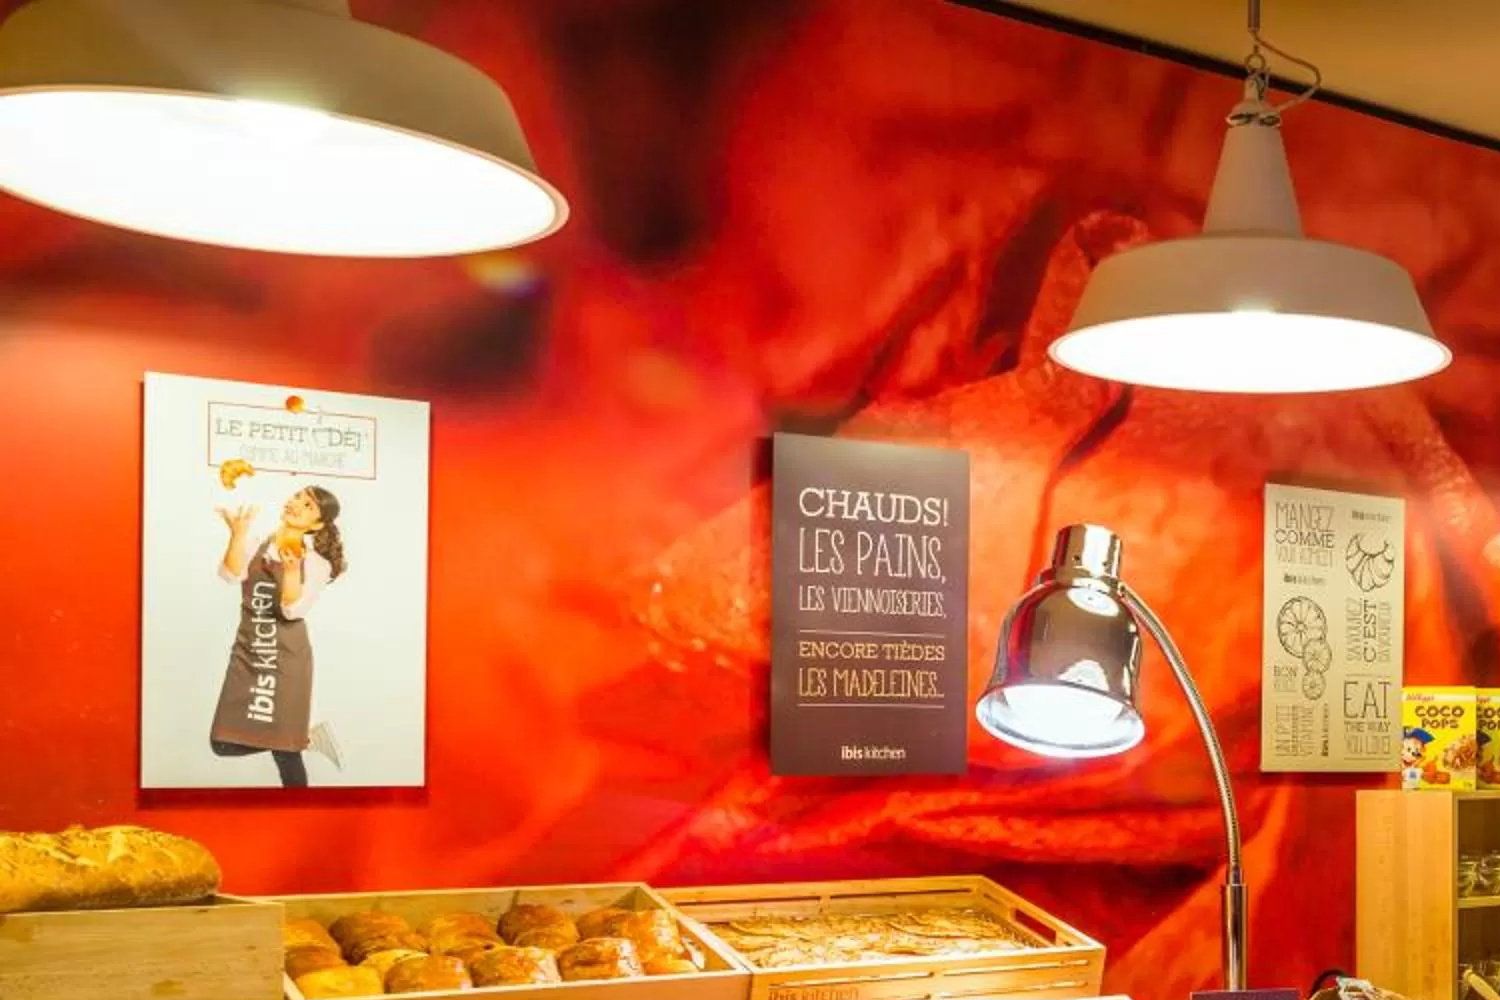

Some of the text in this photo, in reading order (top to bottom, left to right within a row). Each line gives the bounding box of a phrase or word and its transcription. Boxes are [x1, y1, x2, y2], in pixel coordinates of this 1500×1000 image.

[215, 418, 242, 437] LE
[249, 421, 308, 443] PETIT
[799, 487, 949, 527] CHAUDS!
[1275, 529, 1336, 548] COMME
[799, 527, 947, 584] LES PAINS,
[799, 586, 947, 619] LES VIENNOISERIES,
[1364, 599, 1377, 663] C'EST
[248, 581, 278, 723] ibis kitchen
[799, 639, 945, 661] ENCORE TIÈDES
[799, 668, 827, 698] LES
[1343, 680, 1392, 719] EAT
[1415, 706, 1464, 718] COCO
[1421, 719, 1459, 730] POPS
[841, 744, 907, 761] ibis kitchen
